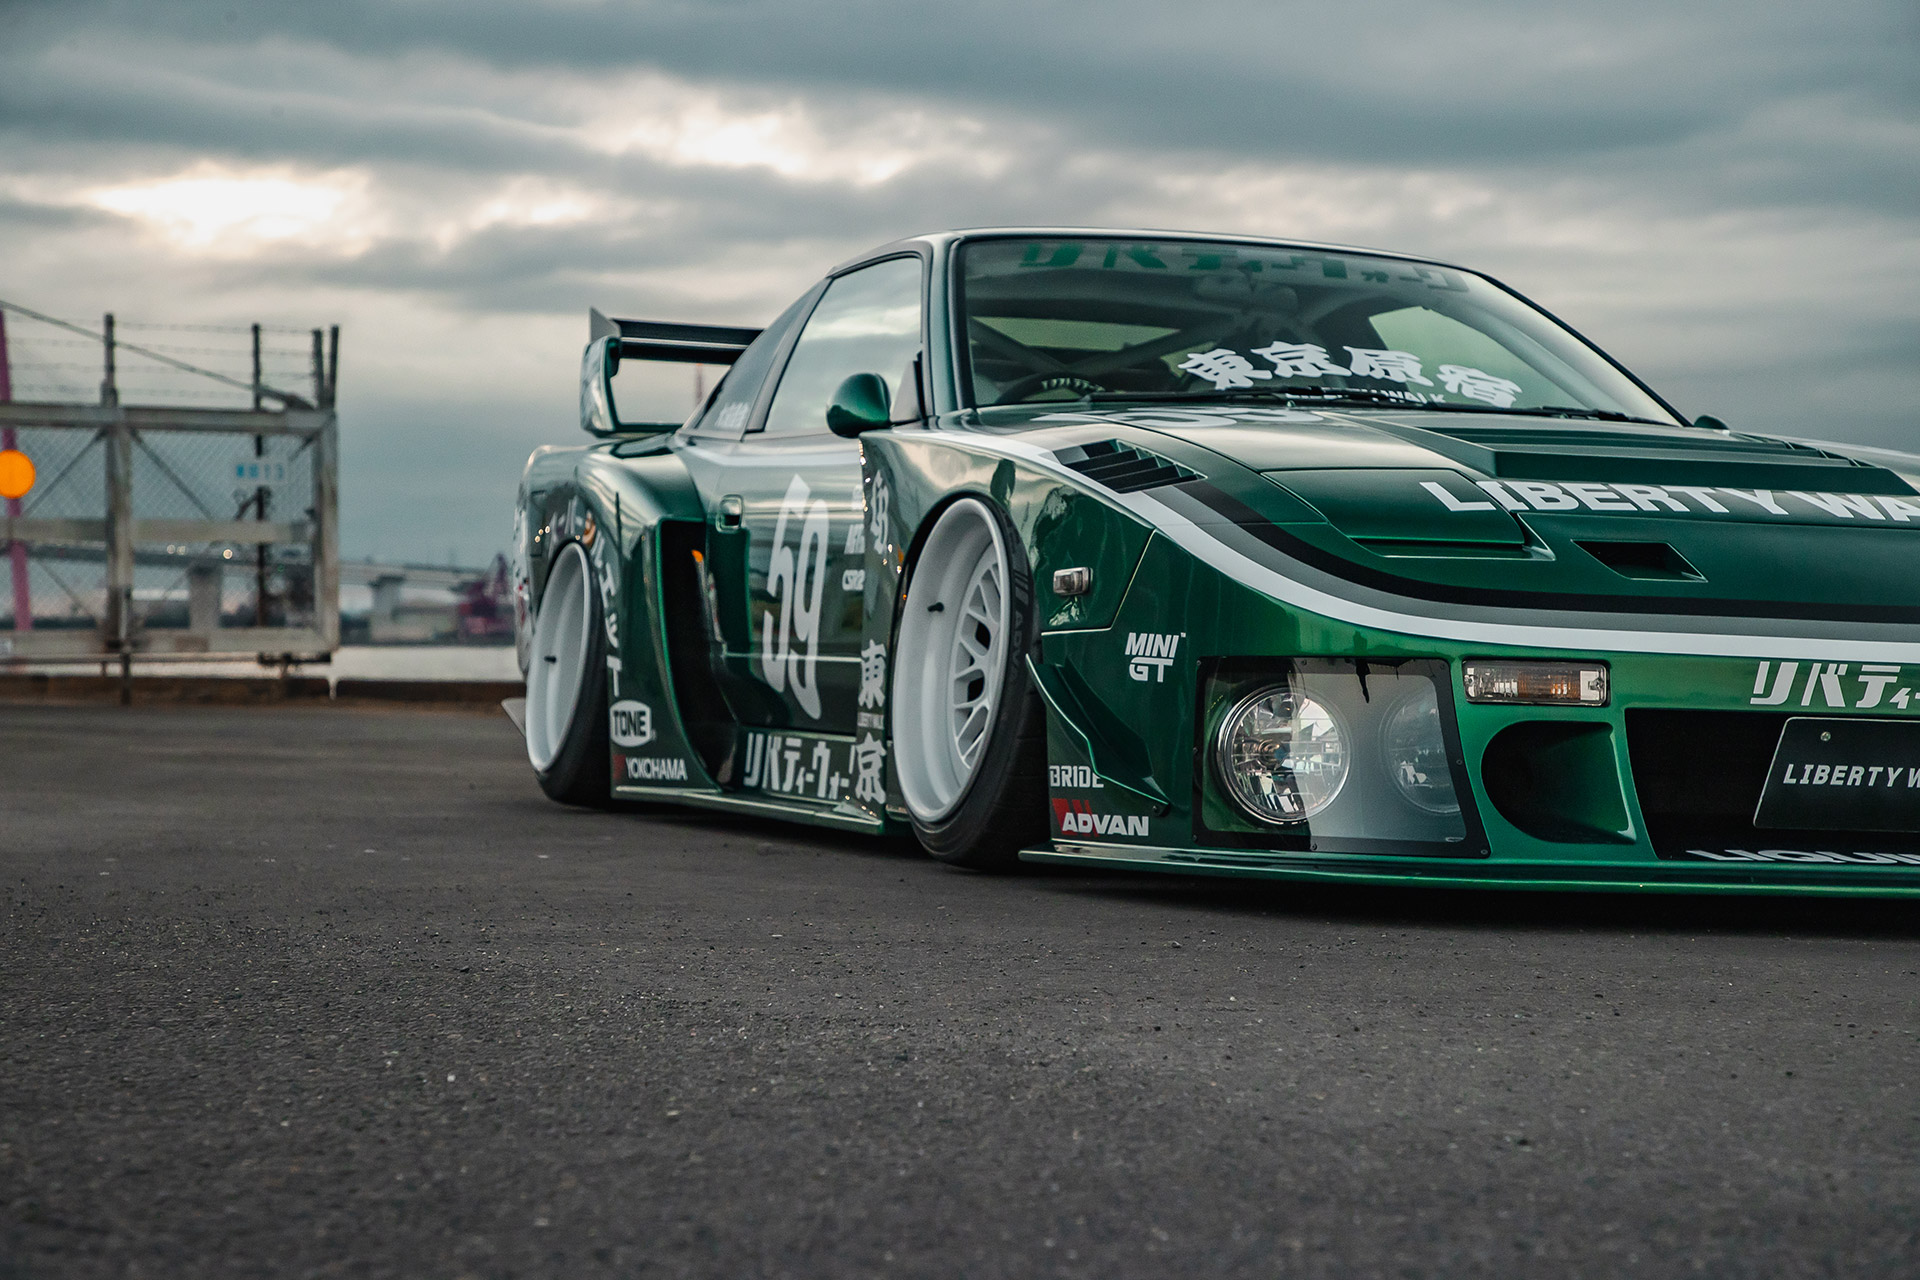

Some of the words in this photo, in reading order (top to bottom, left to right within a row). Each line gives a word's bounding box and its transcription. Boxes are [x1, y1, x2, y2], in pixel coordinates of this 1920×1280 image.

[1420, 480, 1789, 515] LIBERTY
[762, 473, 829, 720] 59
[1125, 632, 1179, 658] MINI
[1129, 656, 1173, 683] GT
[613, 710, 647, 738] TONE
[625, 757, 688, 780] YOKOHAMA
[1783, 763, 1903, 788] LIBERTY
[1062, 812, 1149, 837] ADVAN
